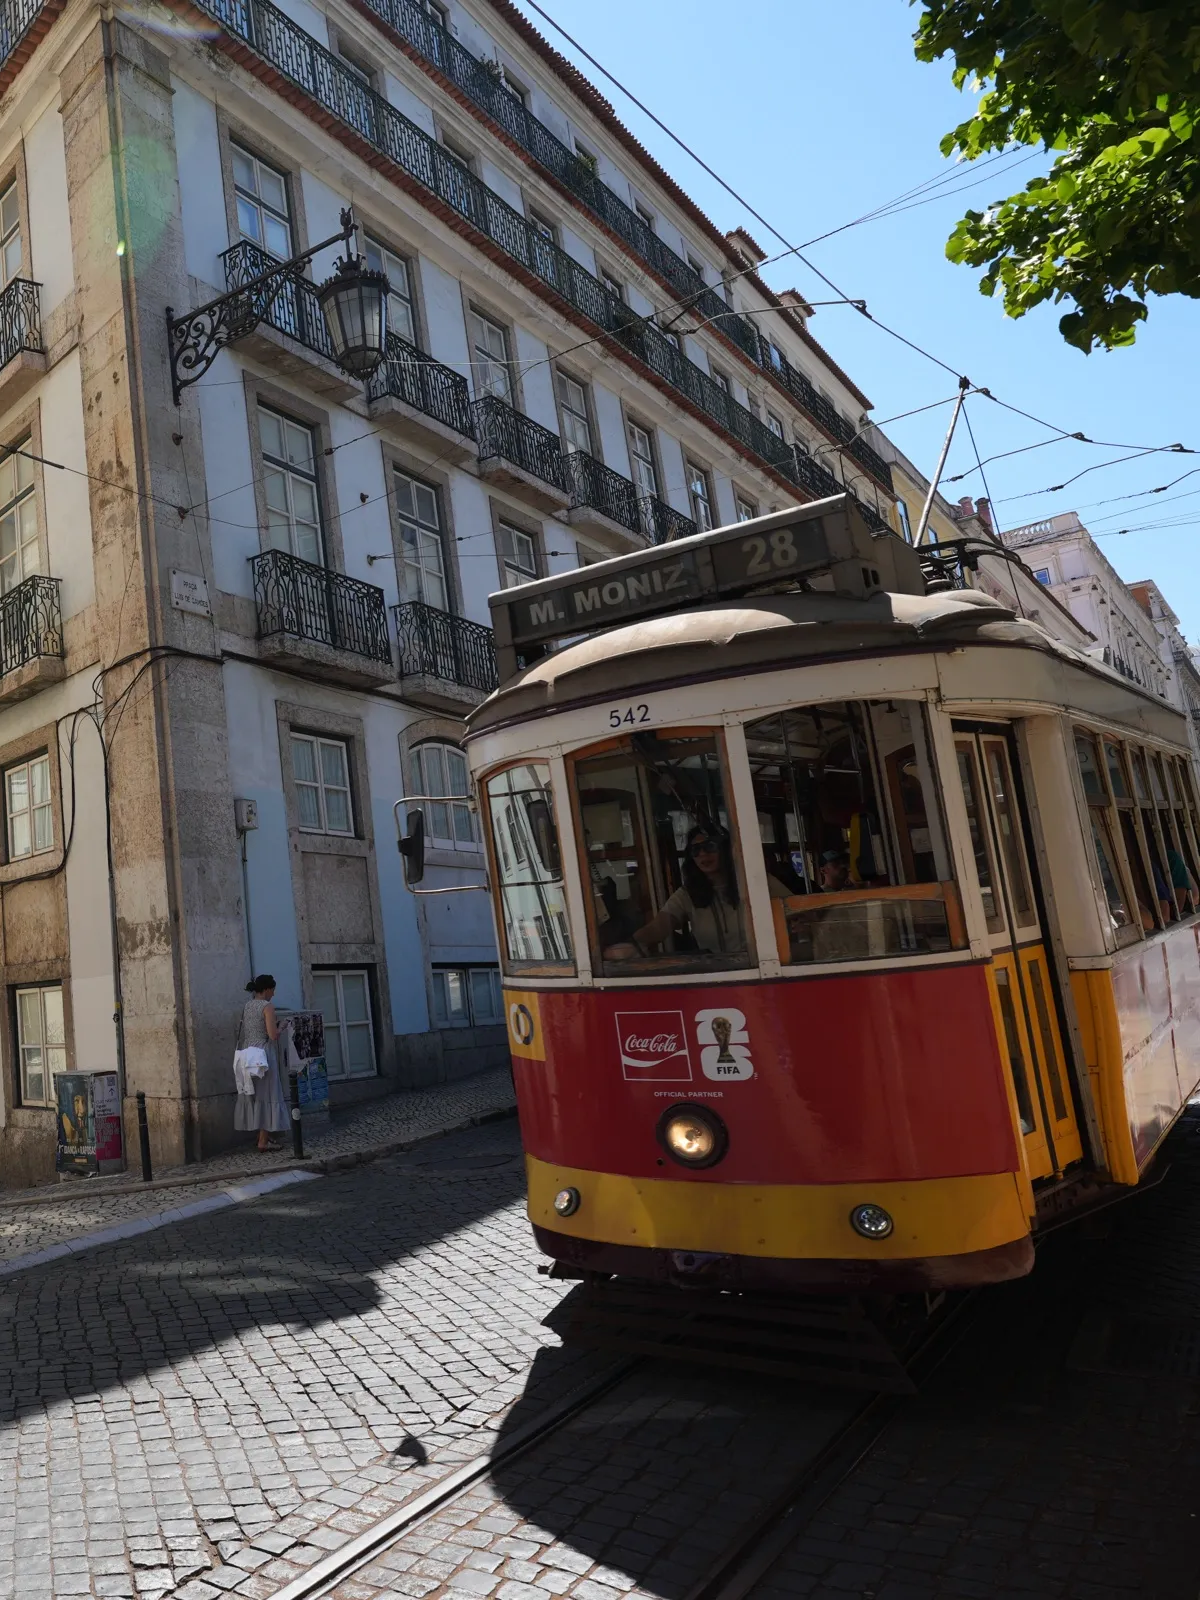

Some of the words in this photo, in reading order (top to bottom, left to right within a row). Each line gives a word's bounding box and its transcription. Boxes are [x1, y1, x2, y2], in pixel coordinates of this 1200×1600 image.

[741, 528, 800, 577] 28
[528, 602, 566, 627] M.
[573, 562, 689, 615] MONIZ
[608, 703, 651, 728] 542
[625, 1033, 679, 1053] Coca-Cola
[716, 1066, 741, 1075] FIFA
